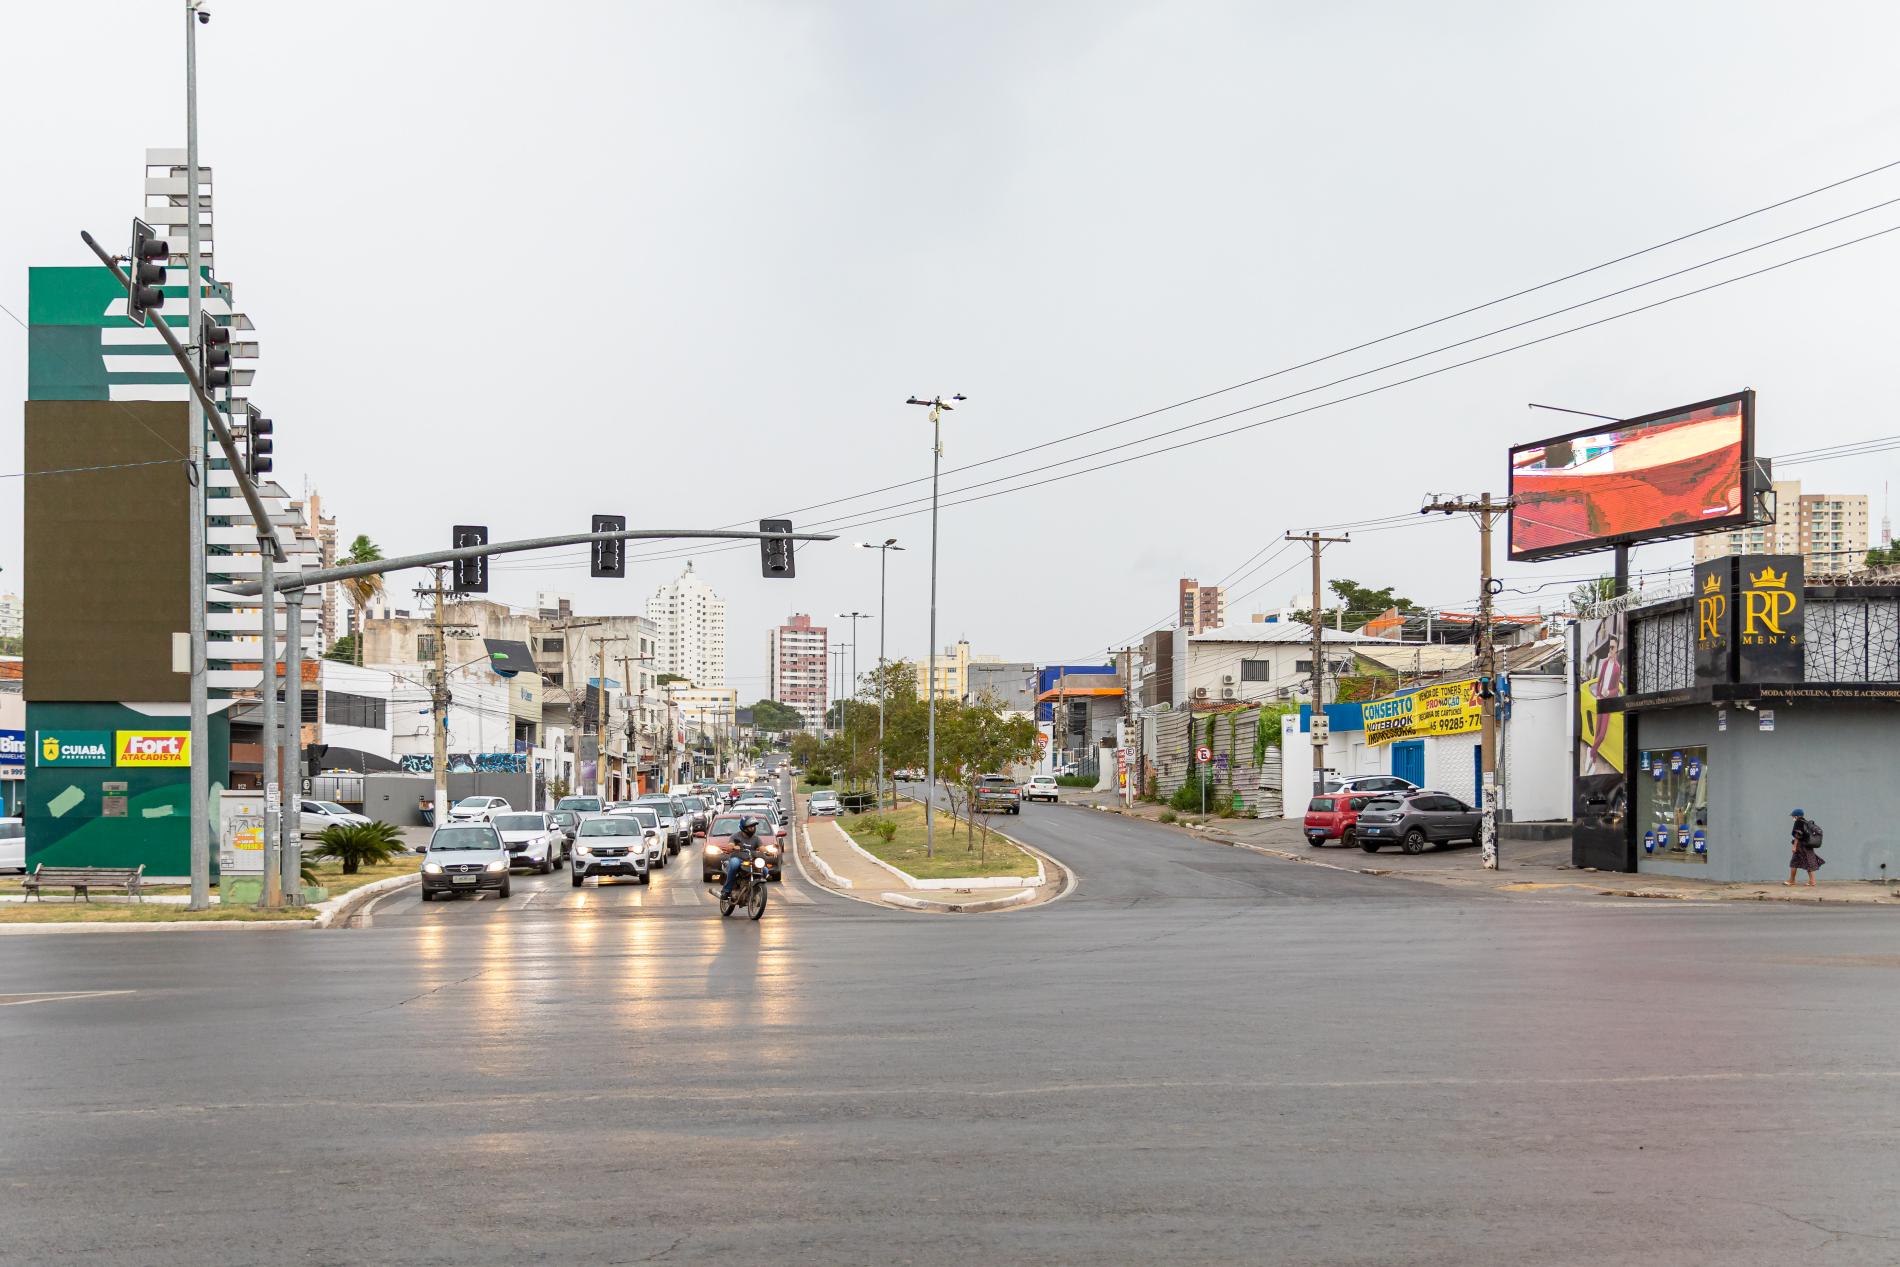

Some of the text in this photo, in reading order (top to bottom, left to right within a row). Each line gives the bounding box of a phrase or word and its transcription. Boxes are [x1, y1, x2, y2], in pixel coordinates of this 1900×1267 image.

[1698, 594, 1726, 641] RP
[1742, 590, 1797, 634] RP
[1742, 635, 1797, 645] MEN'S
[1760, 689, 1783, 697] MODA
[1364, 696, 1413, 720] CONSERTO
[1367, 715, 1413, 732] NOTEBOOK
[61, 743, 106, 755] CUIABÁ
[130, 736, 180, 755] Fort
